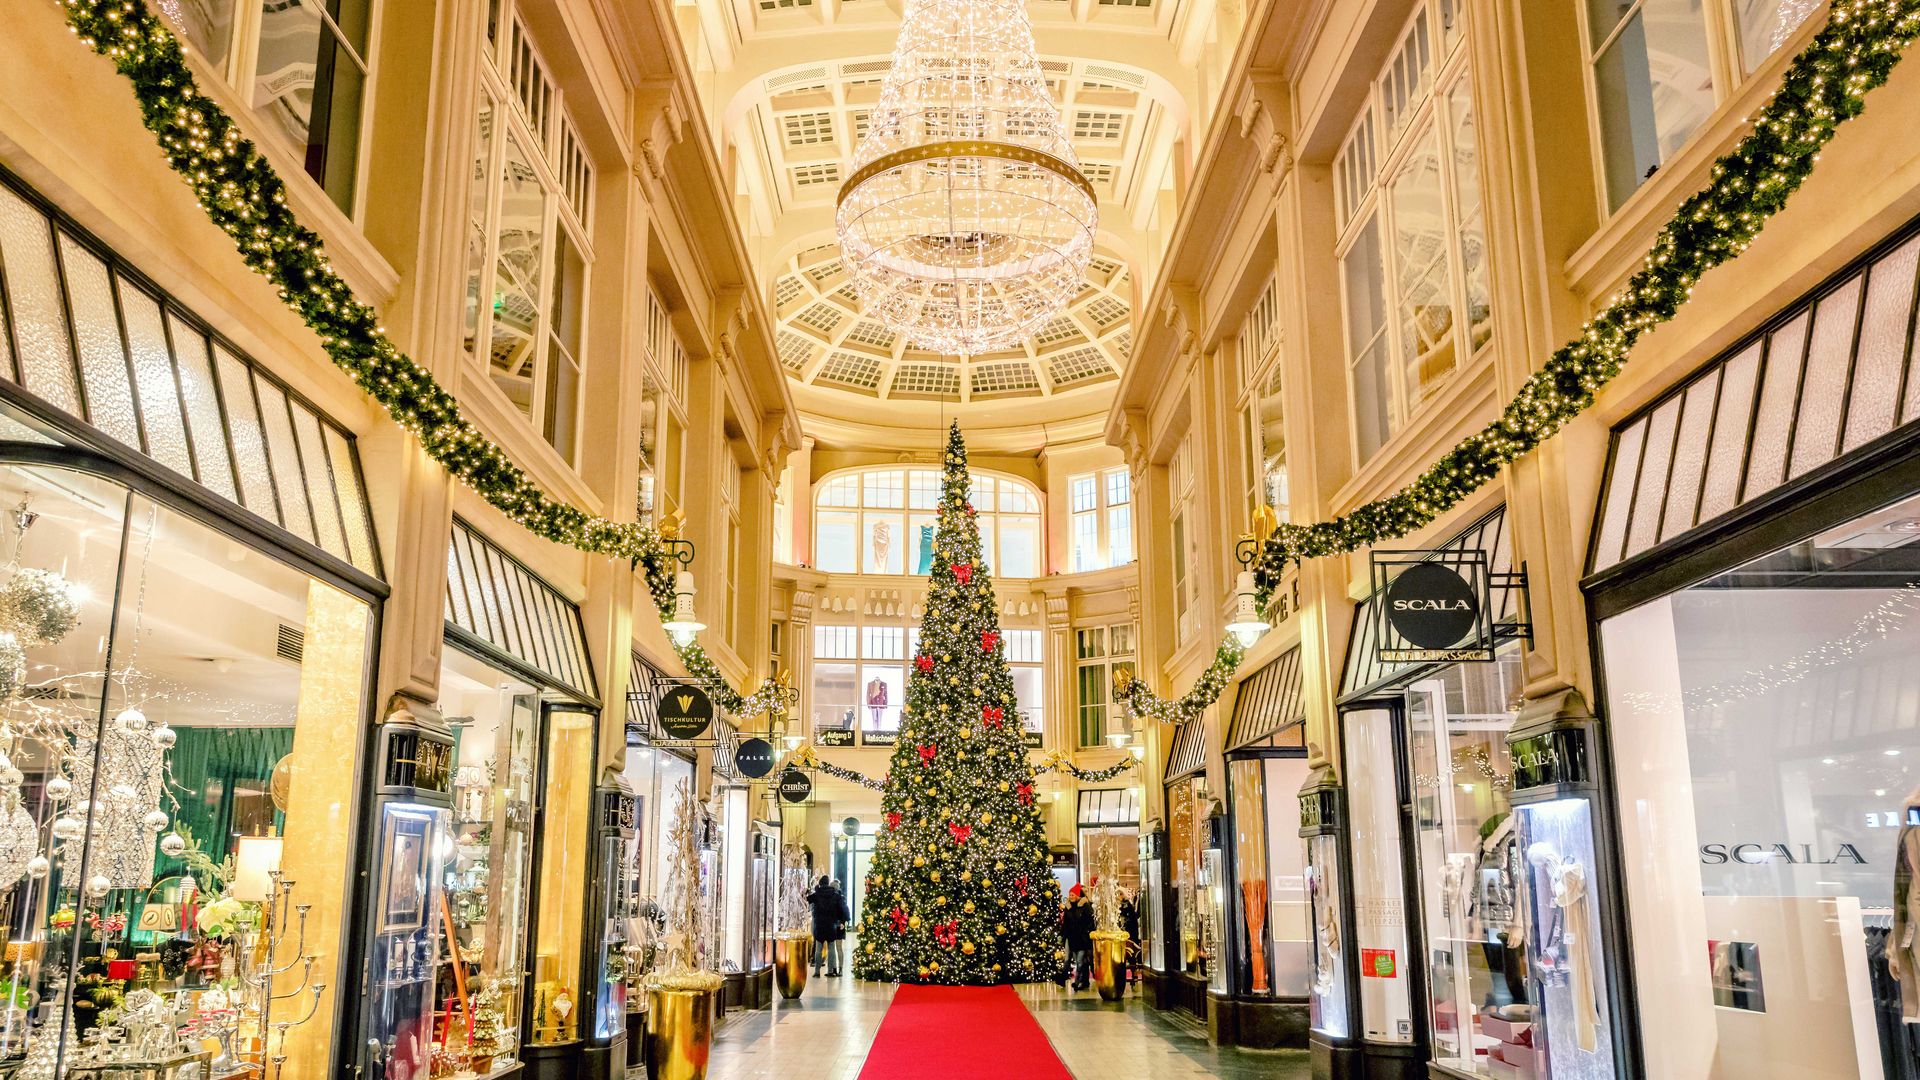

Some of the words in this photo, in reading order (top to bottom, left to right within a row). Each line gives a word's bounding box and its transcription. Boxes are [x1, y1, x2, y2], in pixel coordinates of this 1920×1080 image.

[1393, 599, 1471, 611] SCALA
[827, 731, 847, 740] Aufgang
[847, 731, 852, 739] D
[1510, 748, 1559, 770] SCALA
[1700, 843, 1869, 865] SCALA
